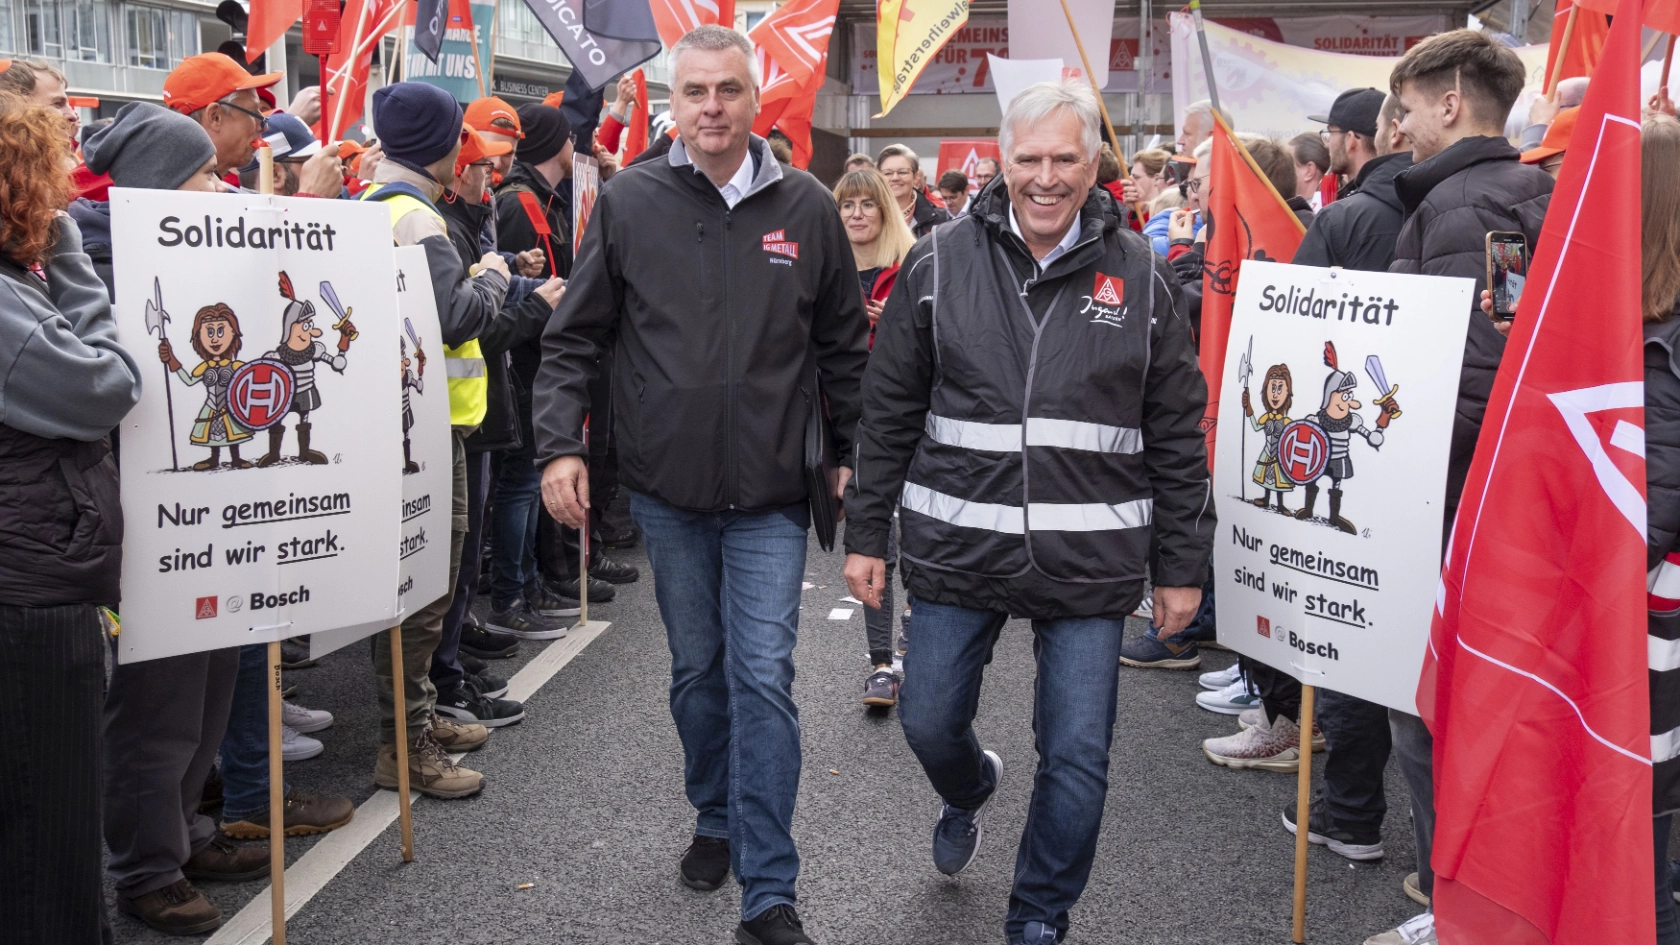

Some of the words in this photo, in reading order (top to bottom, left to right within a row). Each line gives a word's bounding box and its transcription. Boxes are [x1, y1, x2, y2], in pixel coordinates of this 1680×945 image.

[546, 0, 606, 66] ICATO
[1314, 34, 1399, 50] SOLIDARITÄT
[935, 46, 968, 64] FÜR
[500, 80, 527, 94] BUSINESS
[528, 85, 549, 96] CENTER
[158, 215, 336, 251] Solidarität
[763, 231, 783, 241] TEAM
[763, 243, 771, 251] IG
[771, 243, 797, 257] METALL
[1259, 284, 1400, 327] Solidarität
[158, 502, 210, 529] Nur
[222, 492, 351, 529] gemeinsam
[158, 543, 213, 573] sind
[225, 541, 266, 566] wir
[277, 529, 345, 561] stark.
[1233, 524, 1263, 552] Nur
[1269, 543, 1379, 587] gemeinsam
[250, 585, 310, 611] Bosch
[1234, 567, 1265, 592] sind
[1273, 582, 1297, 604] wir
[1305, 594, 1373, 627] stark.
[1289, 631, 1339, 661] Bosch
